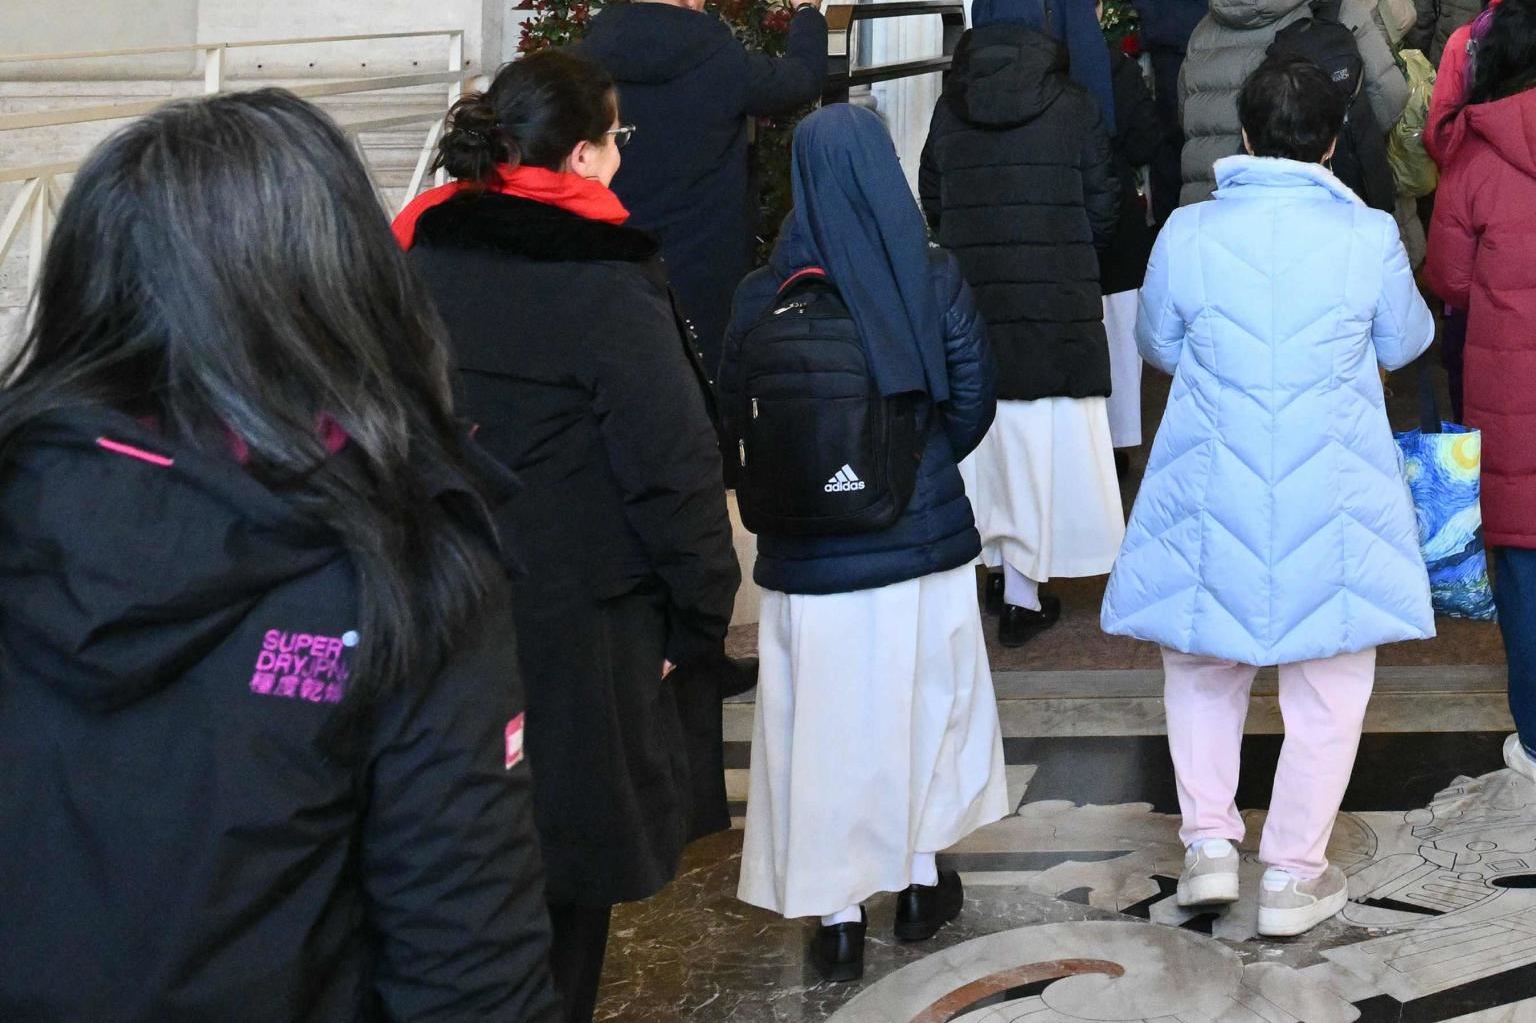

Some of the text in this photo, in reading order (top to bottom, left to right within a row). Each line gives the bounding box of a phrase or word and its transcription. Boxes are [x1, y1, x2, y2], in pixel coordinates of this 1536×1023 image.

[824, 481, 865, 492] adidas
[264, 630, 342, 658] SUPER
[256, 650, 308, 674] DRY
